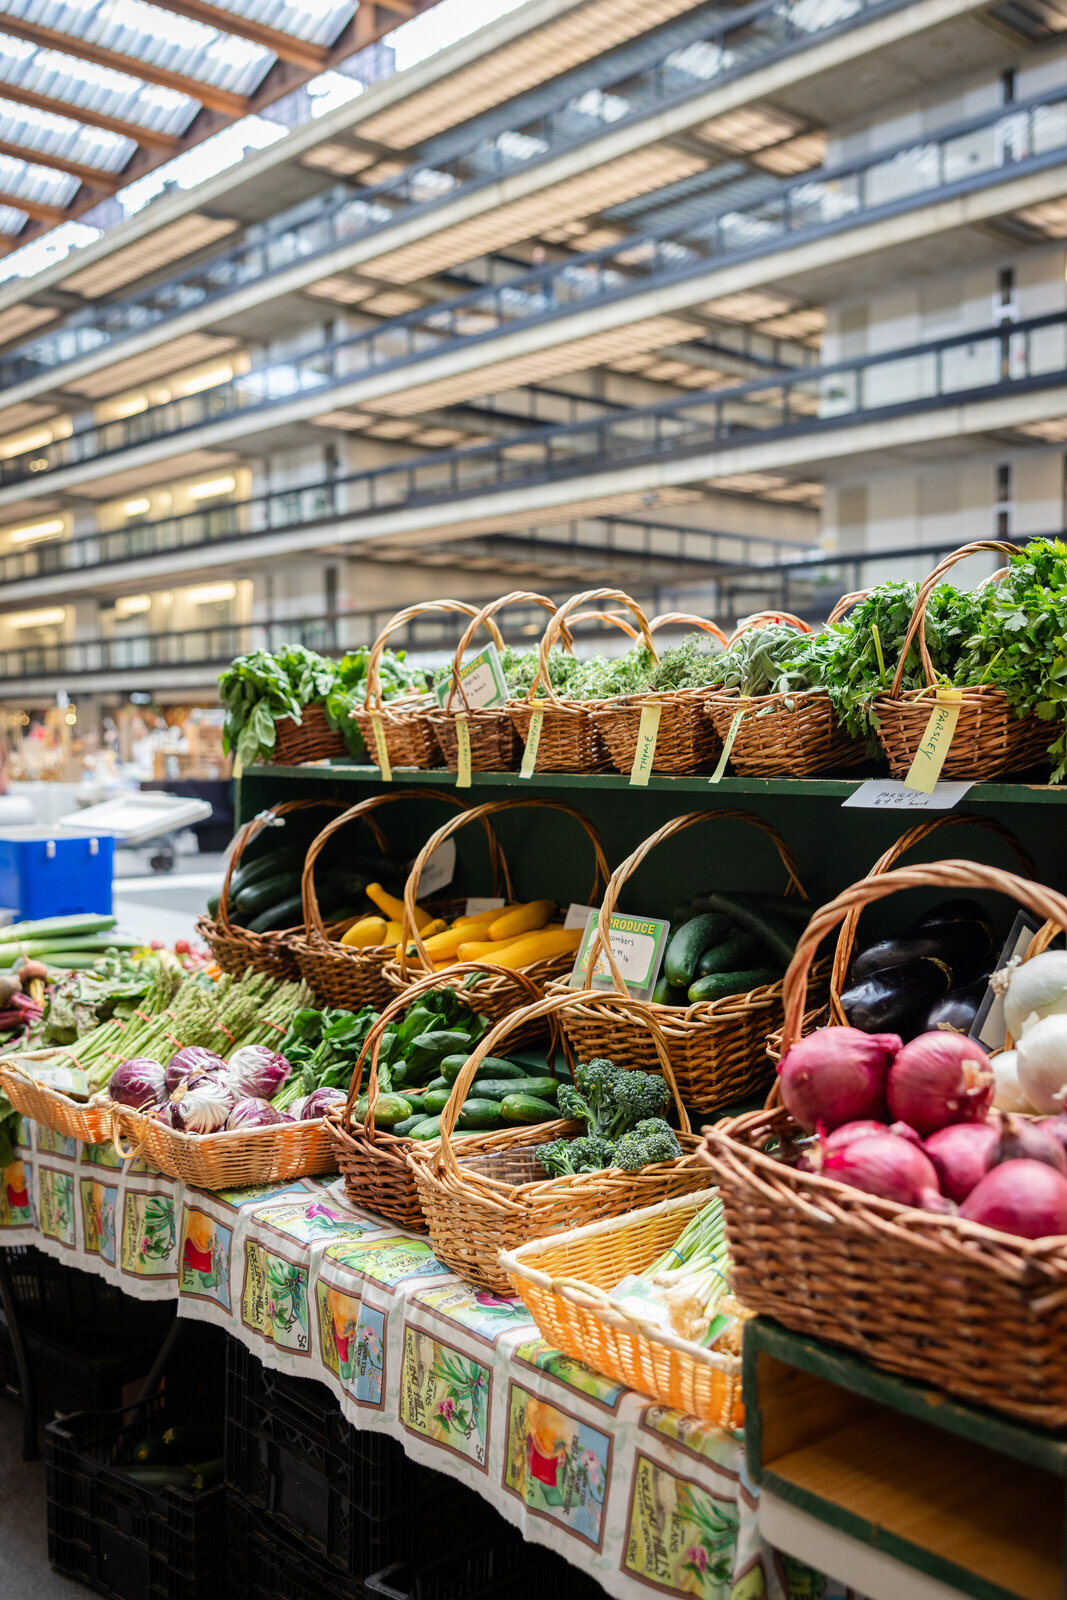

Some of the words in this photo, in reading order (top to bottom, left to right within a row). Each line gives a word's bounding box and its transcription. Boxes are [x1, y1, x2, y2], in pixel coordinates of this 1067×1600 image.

[447, 654, 486, 689] PODUCE
[918, 707, 949, 760] PARSLEY
[609, 935, 635, 947] cumbers
[425, 1373, 437, 1406] BEANS
[414, 1392, 426, 1429] HILLS
[642, 1464, 661, 1530] ROLLING
[652, 1535, 672, 1580] HILLS
